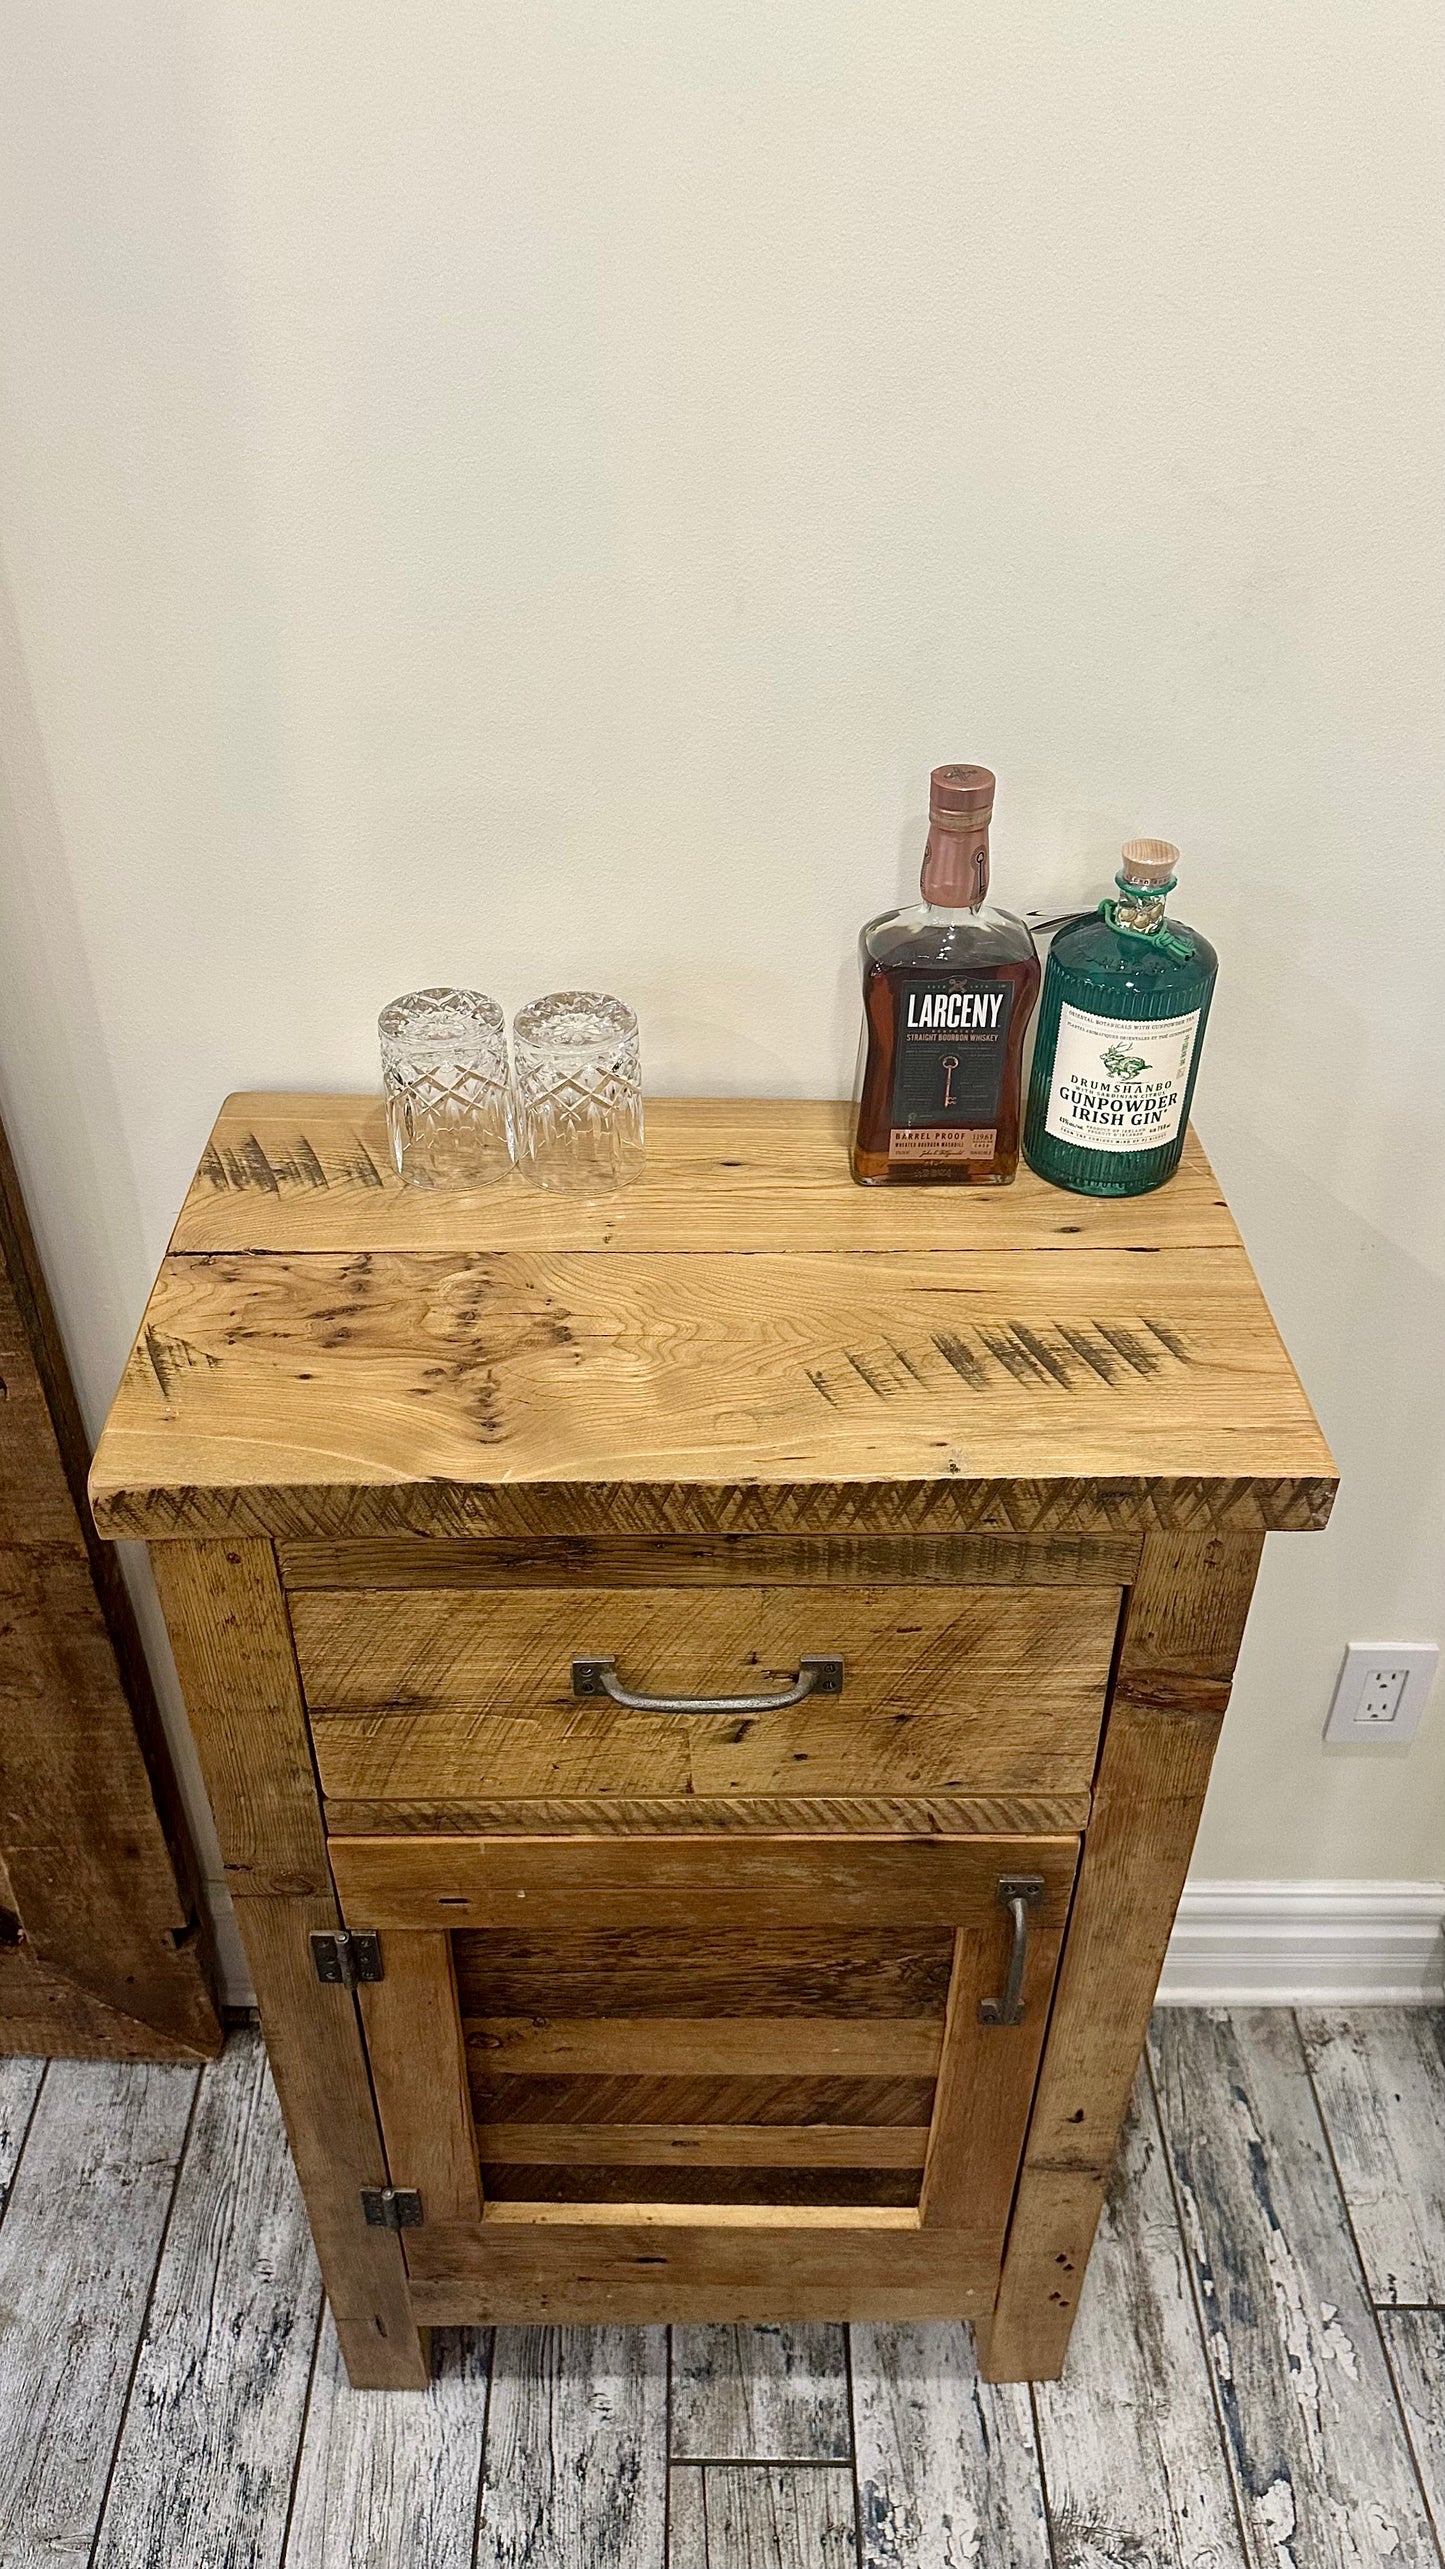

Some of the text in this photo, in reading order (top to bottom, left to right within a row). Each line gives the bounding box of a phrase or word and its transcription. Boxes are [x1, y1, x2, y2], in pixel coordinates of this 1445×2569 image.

[907, 993, 1004, 1028] LARCENY
[1069, 1010, 1094, 1024] ORIENTAL
[1096, 1020, 1132, 1030] BOTANICALS
[1151, 1020, 1185, 1030] GUNPOWDER
[906, 1034, 937, 1042] STRAIGHT
[970, 1034, 999, 1042] WHISKEY
[1070, 1074, 1172, 1094] DRUMSHANBO
[1075, 1086, 1094, 1095] WITH
[1059, 1086, 1178, 1112] GUNPOWDER
[1072, 1105, 1124, 1126] IRISH
